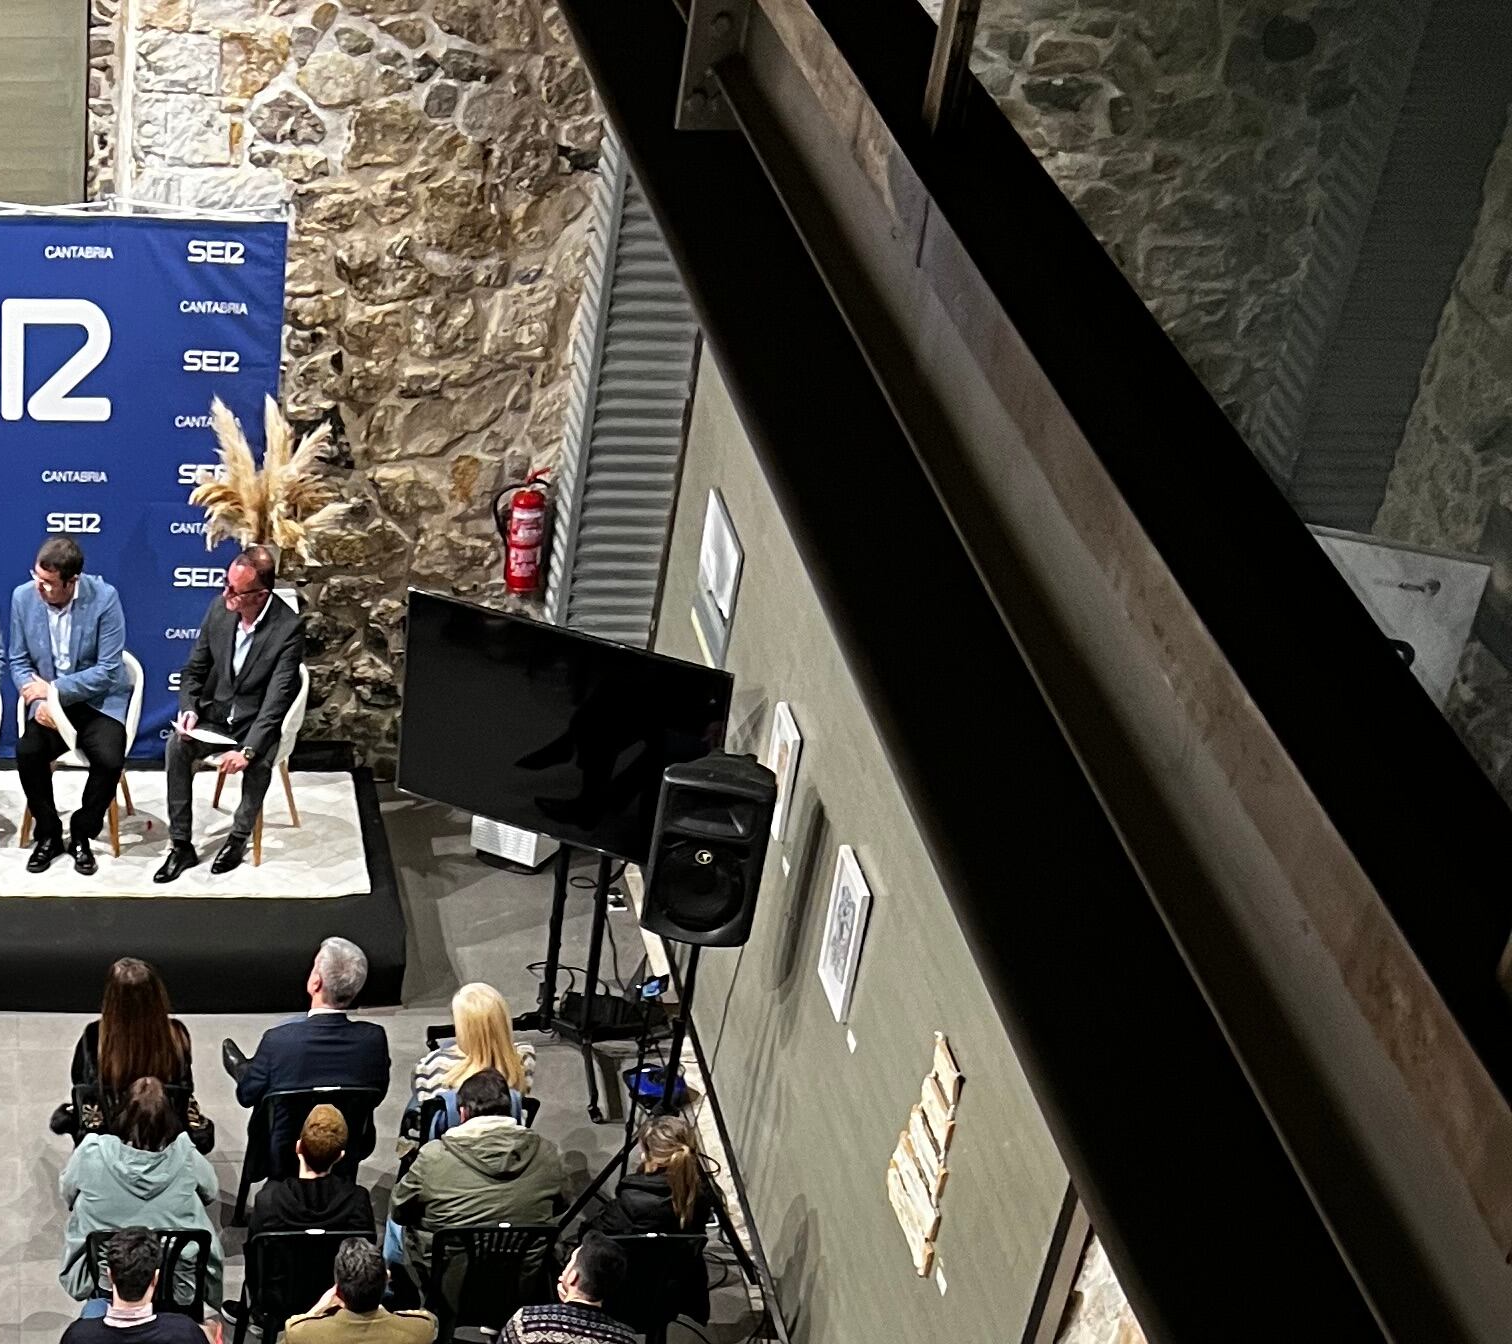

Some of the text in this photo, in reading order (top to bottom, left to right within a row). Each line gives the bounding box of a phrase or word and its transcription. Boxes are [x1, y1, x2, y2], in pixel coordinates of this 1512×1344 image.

[44, 245, 114, 260] CANTABRIA
[187, 239, 245, 265] SER
[179, 300, 249, 315] CANTABRIA
[182, 349, 240, 373] SER
[41, 470, 108, 483] CANTABRIA
[46, 512, 101, 533] SER
[169, 522, 207, 535] CANTA
[172, 567, 227, 588] SER
